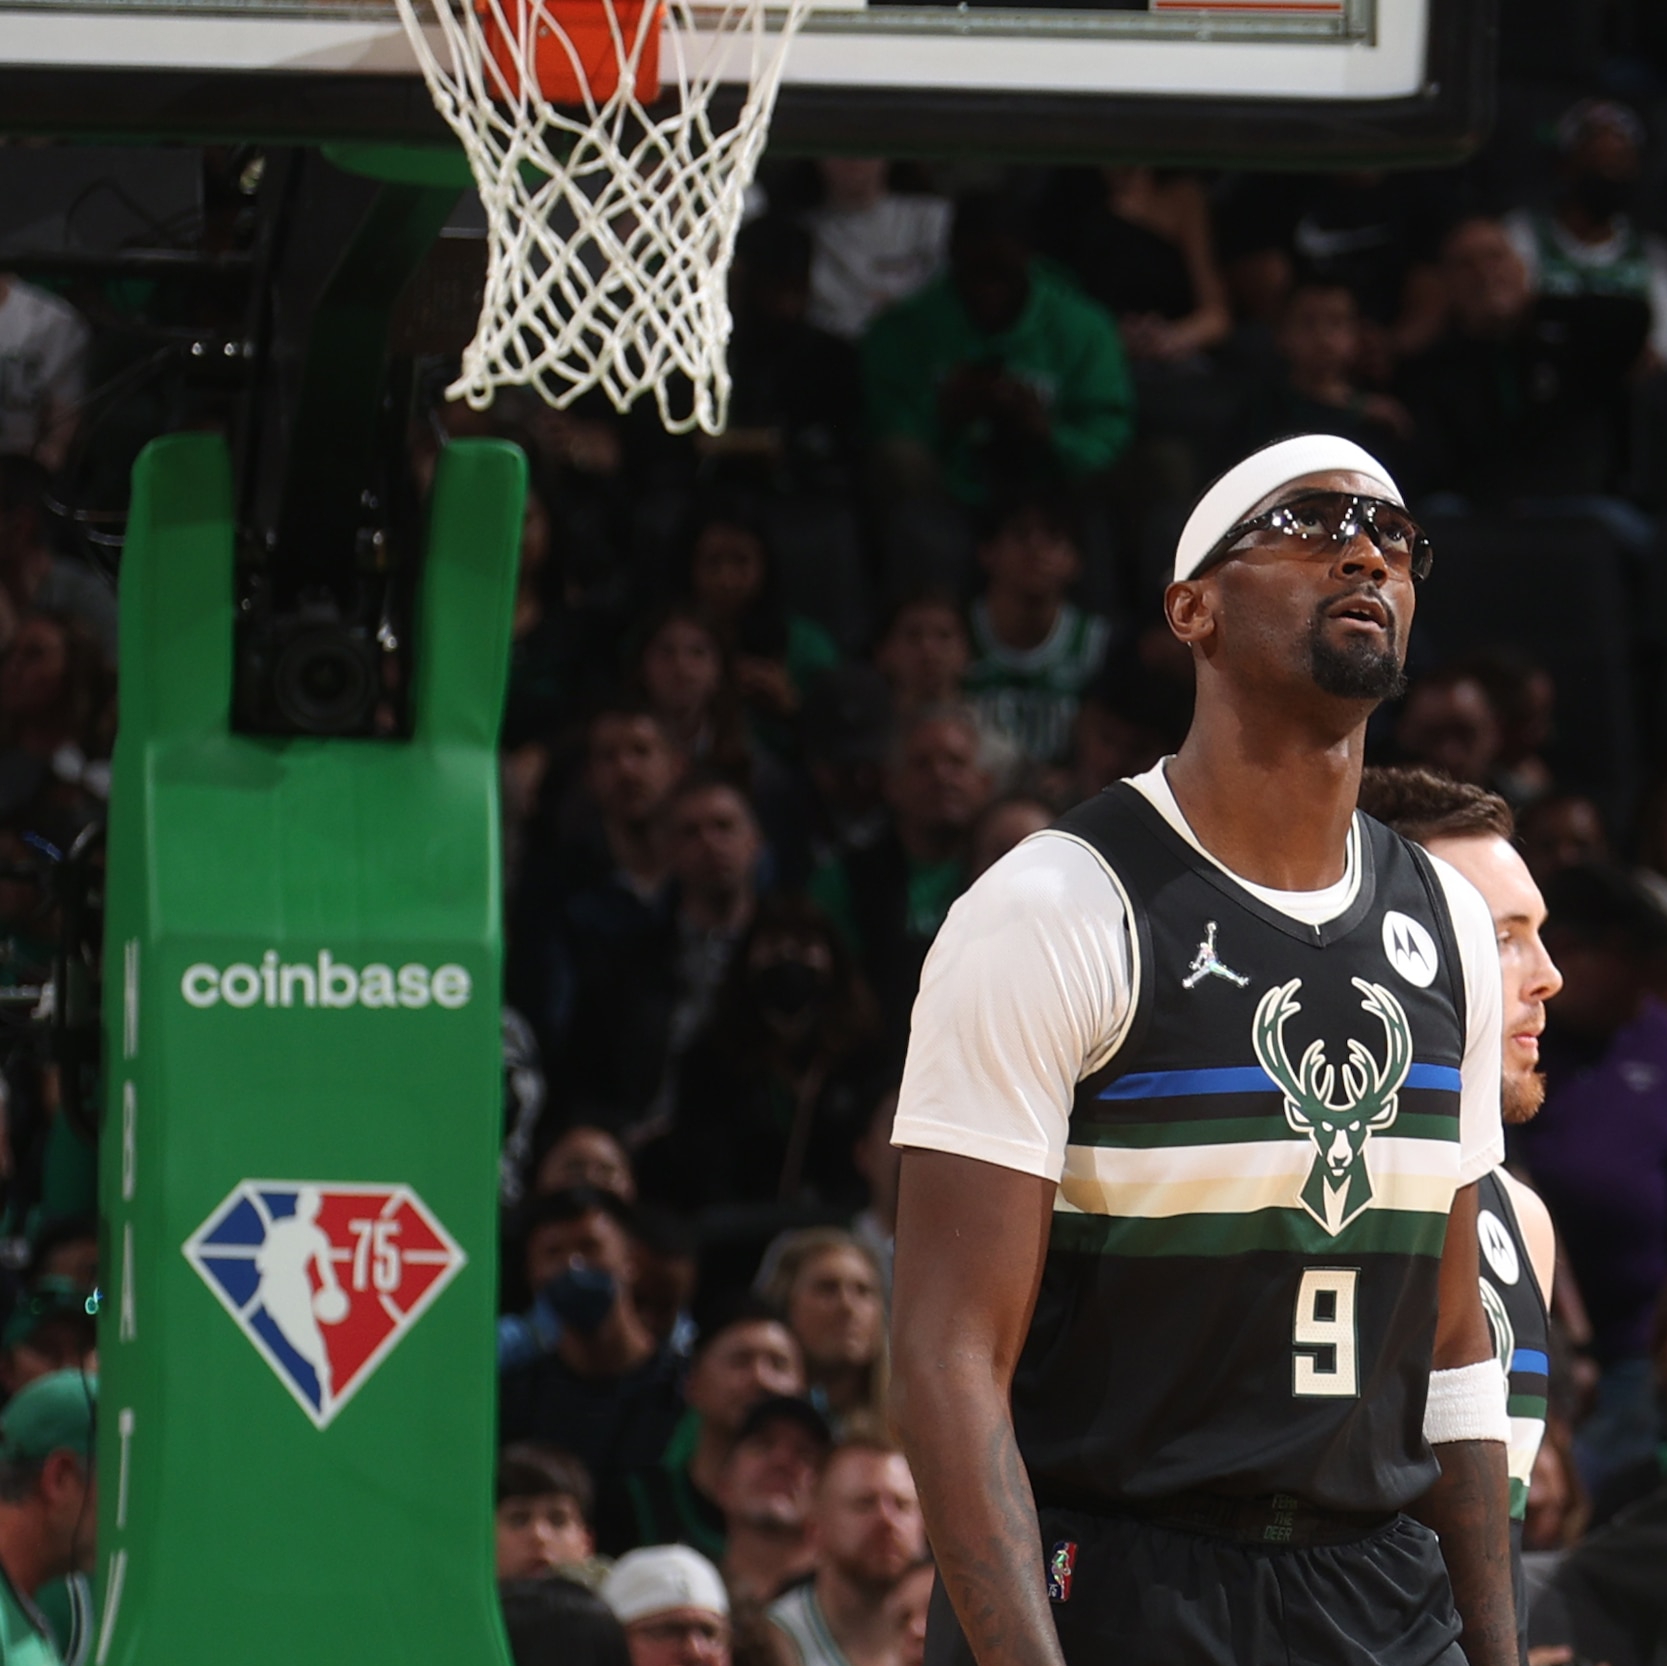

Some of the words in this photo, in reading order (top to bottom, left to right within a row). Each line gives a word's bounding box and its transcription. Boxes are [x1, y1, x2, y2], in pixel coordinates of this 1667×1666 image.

[181, 949, 471, 1010] coinbase
[348, 1219, 402, 1293] 75
[1291, 1265, 1362, 1400] 9
[1263, 1525, 1294, 1542] DEER
